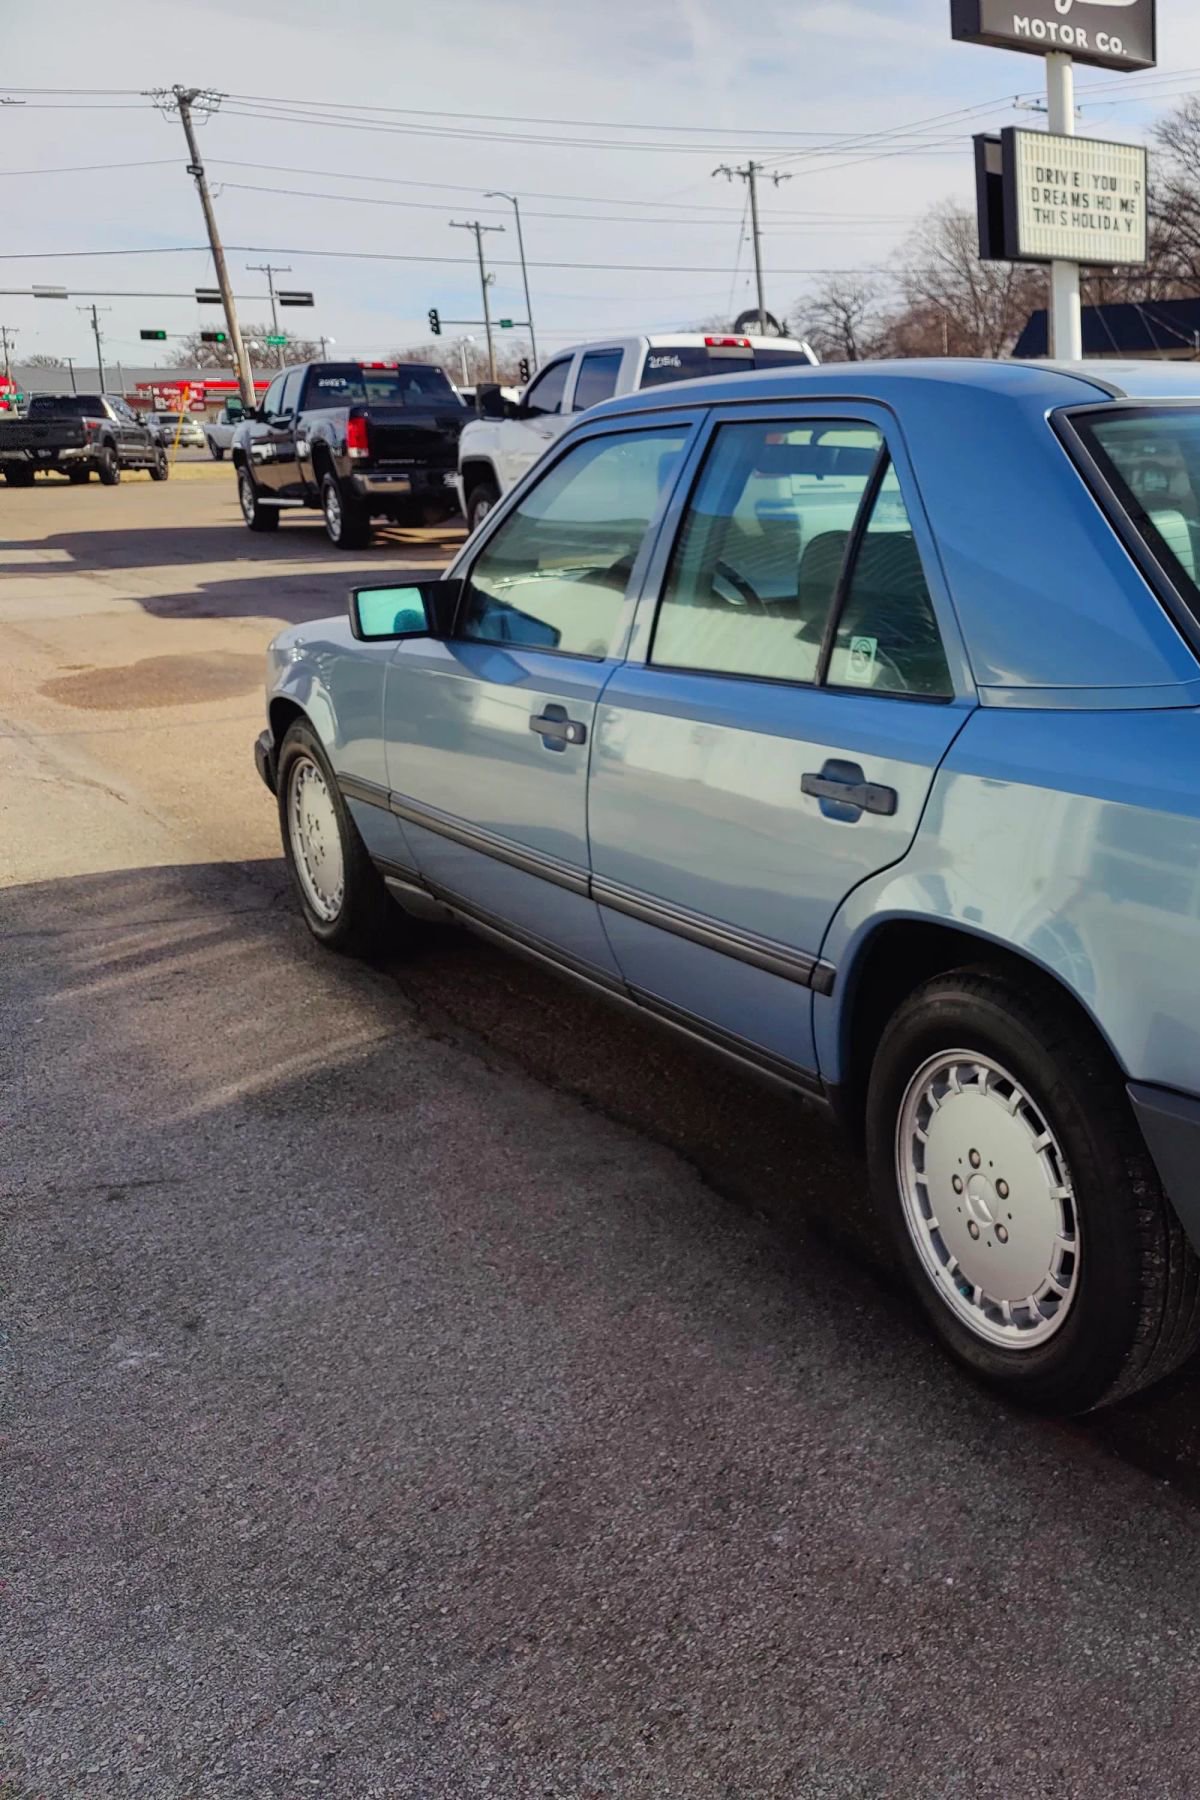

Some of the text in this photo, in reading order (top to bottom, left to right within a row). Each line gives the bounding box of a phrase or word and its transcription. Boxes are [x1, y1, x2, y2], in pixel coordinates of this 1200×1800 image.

[1012, 15, 1128, 55] MOTOR CO.
[1035, 166, 1081, 188] DRIVE
[1031, 188, 1136, 214] DREAMS HOME
[1033, 207, 1135, 233] THIS HOLIDAY
